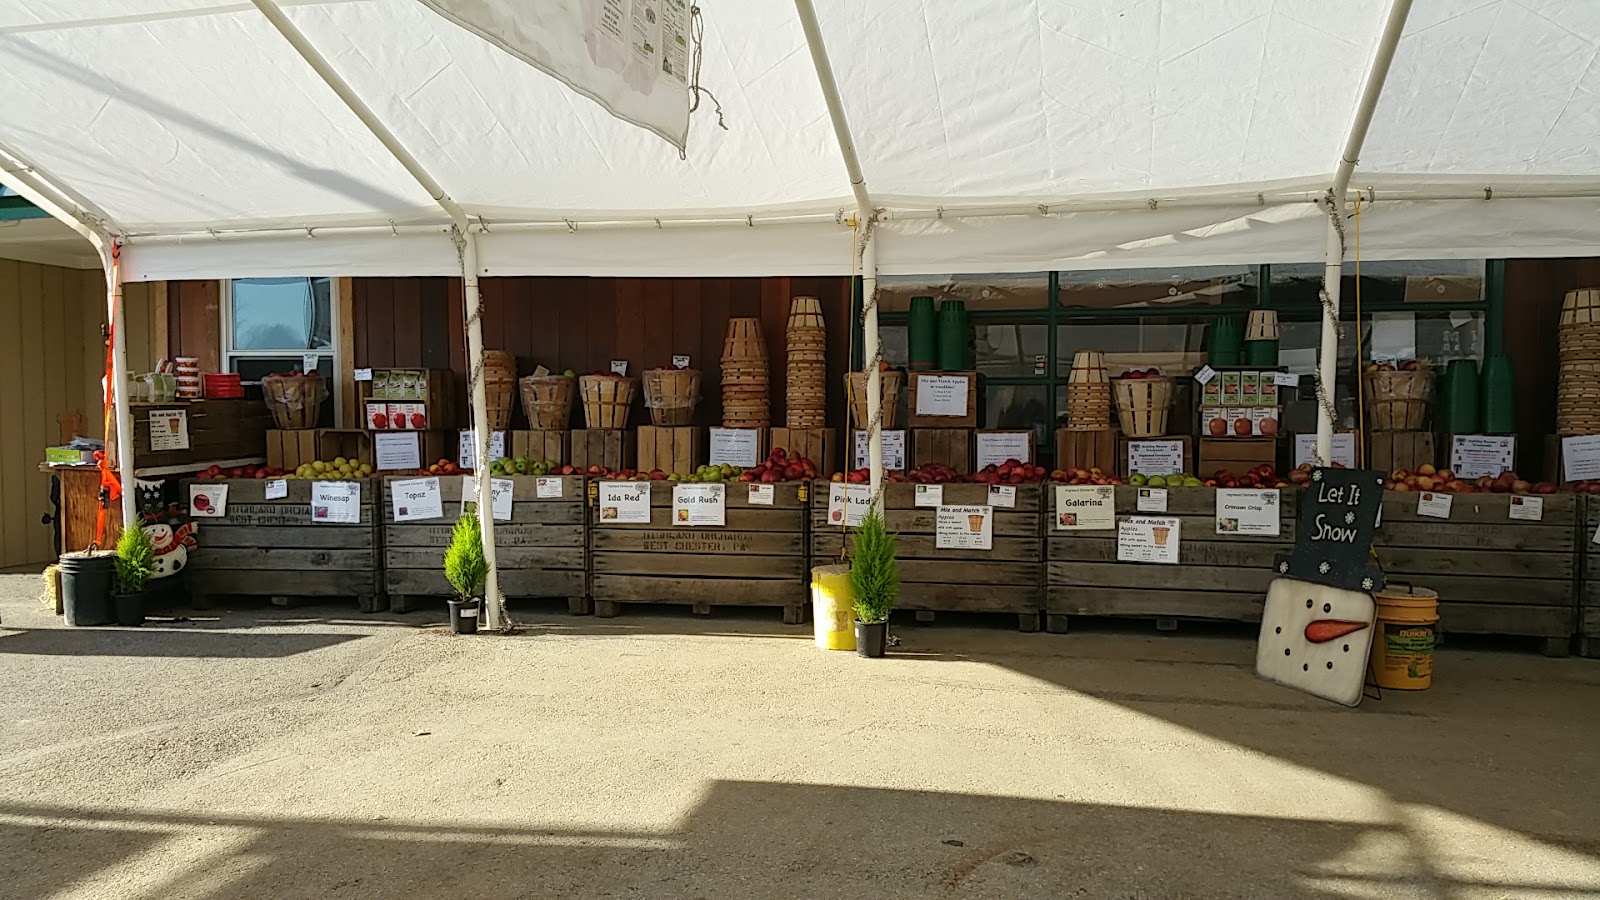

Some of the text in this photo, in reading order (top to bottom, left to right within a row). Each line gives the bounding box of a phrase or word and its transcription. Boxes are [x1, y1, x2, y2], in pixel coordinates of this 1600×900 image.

[1317, 481, 1361, 506] Let It
[320, 494, 349, 503] Winesap
[281, 506, 312, 515] ORCHA
[1310, 513, 1358, 544] Snow
[643, 541, 668, 550] WEST
